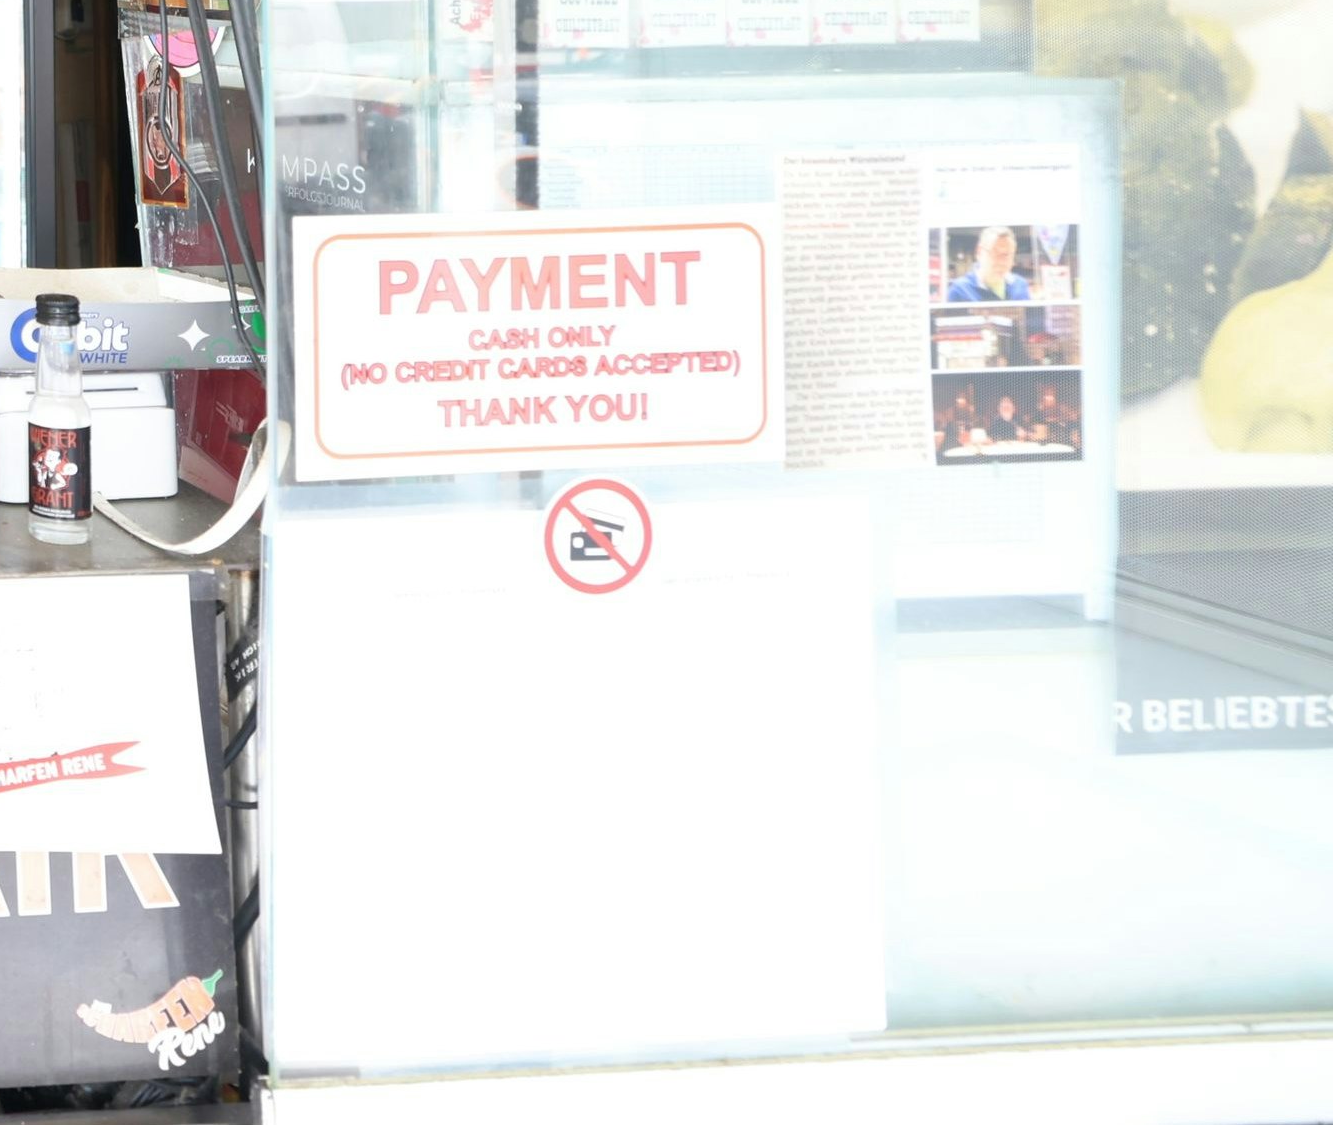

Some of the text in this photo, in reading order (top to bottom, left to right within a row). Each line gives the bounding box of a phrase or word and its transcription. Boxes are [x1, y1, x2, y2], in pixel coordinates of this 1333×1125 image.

[378, 250, 701, 315] PAYMENT
[10, 308, 129, 362] Obit
[468, 325, 617, 351] CASH ONLY
[80, 352, 127, 364] WHITE
[341, 350, 741, 391] (NO CREDIT CARDS ACCEPTED)
[437, 392, 649, 428] THANK YOU!
[30, 427, 77, 448] WIENER
[31, 489, 73, 509] GRANT
[1142, 695, 1333, 733] BELIEBTE
[62, 753, 107, 776] RENE
[148, 1011, 226, 1071] Rene
